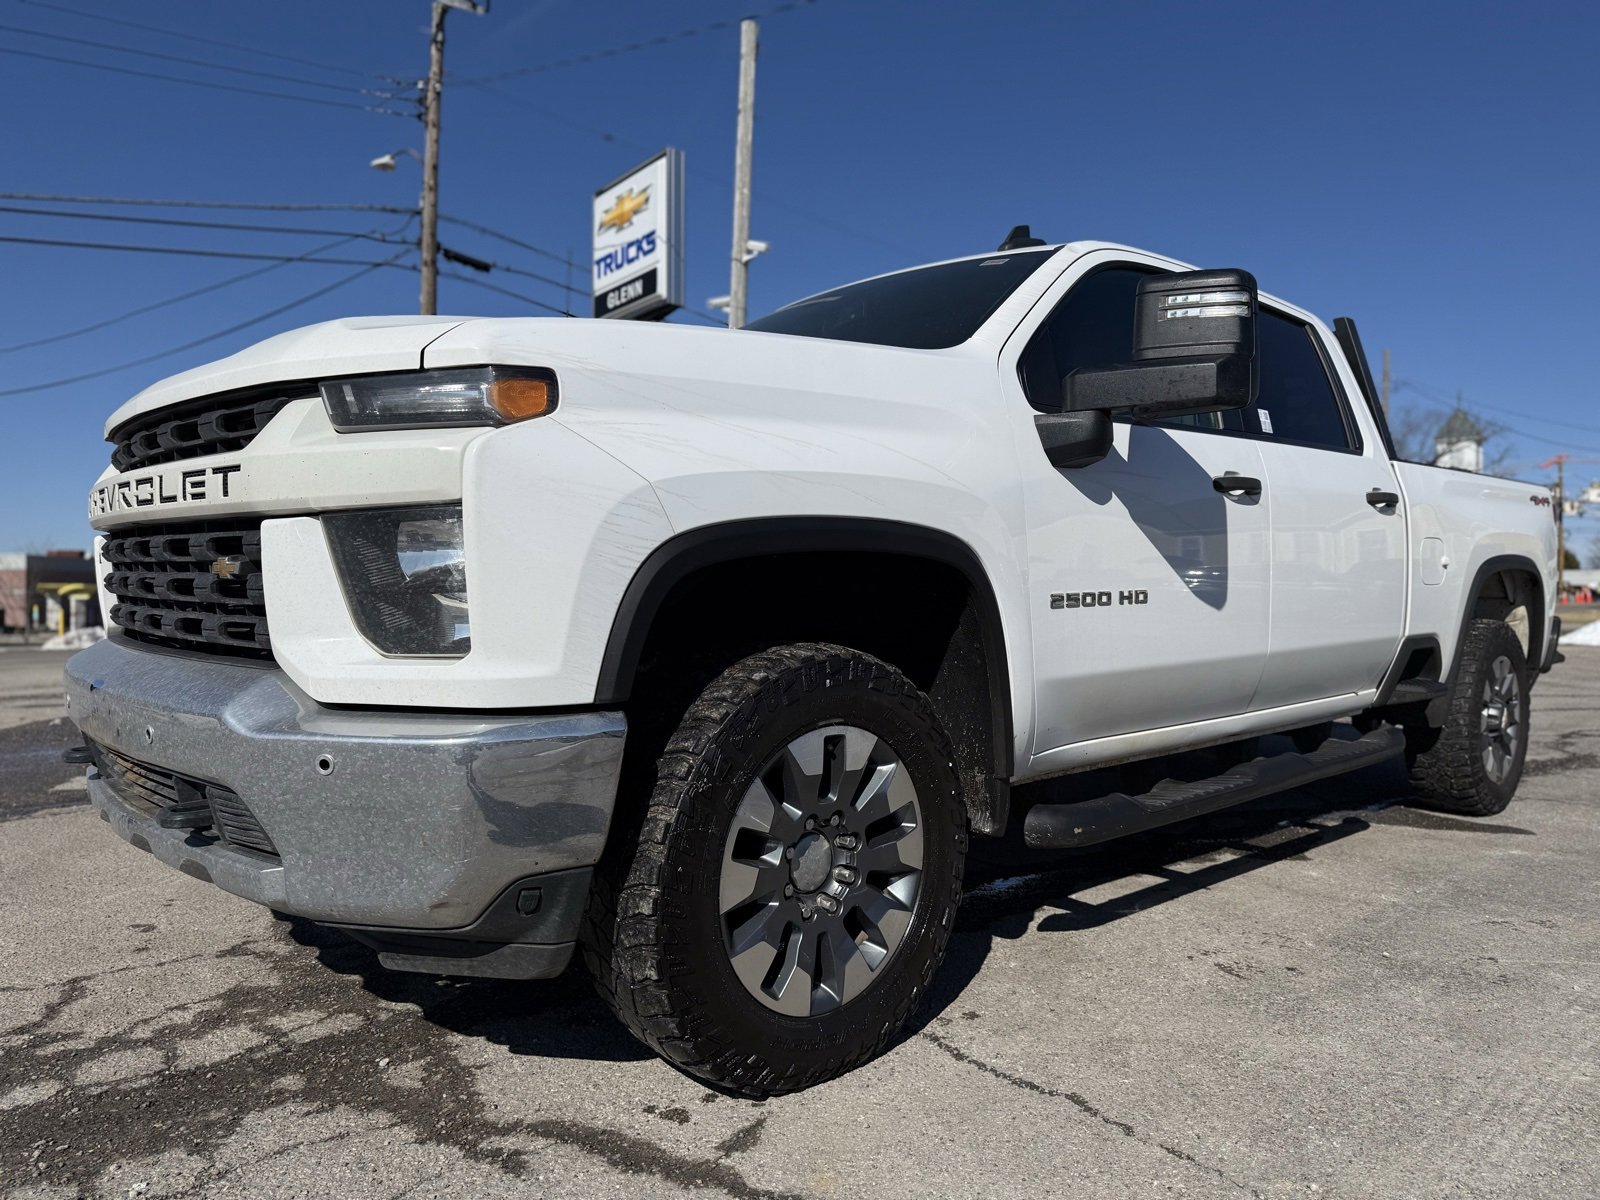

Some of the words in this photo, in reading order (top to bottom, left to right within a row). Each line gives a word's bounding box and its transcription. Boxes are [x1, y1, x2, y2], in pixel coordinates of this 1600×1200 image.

[594, 229, 656, 279] TRUCKS
[606, 278, 644, 309] GLENN
[1050, 590, 1112, 609] 2500
[1118, 589, 1148, 606] HD
